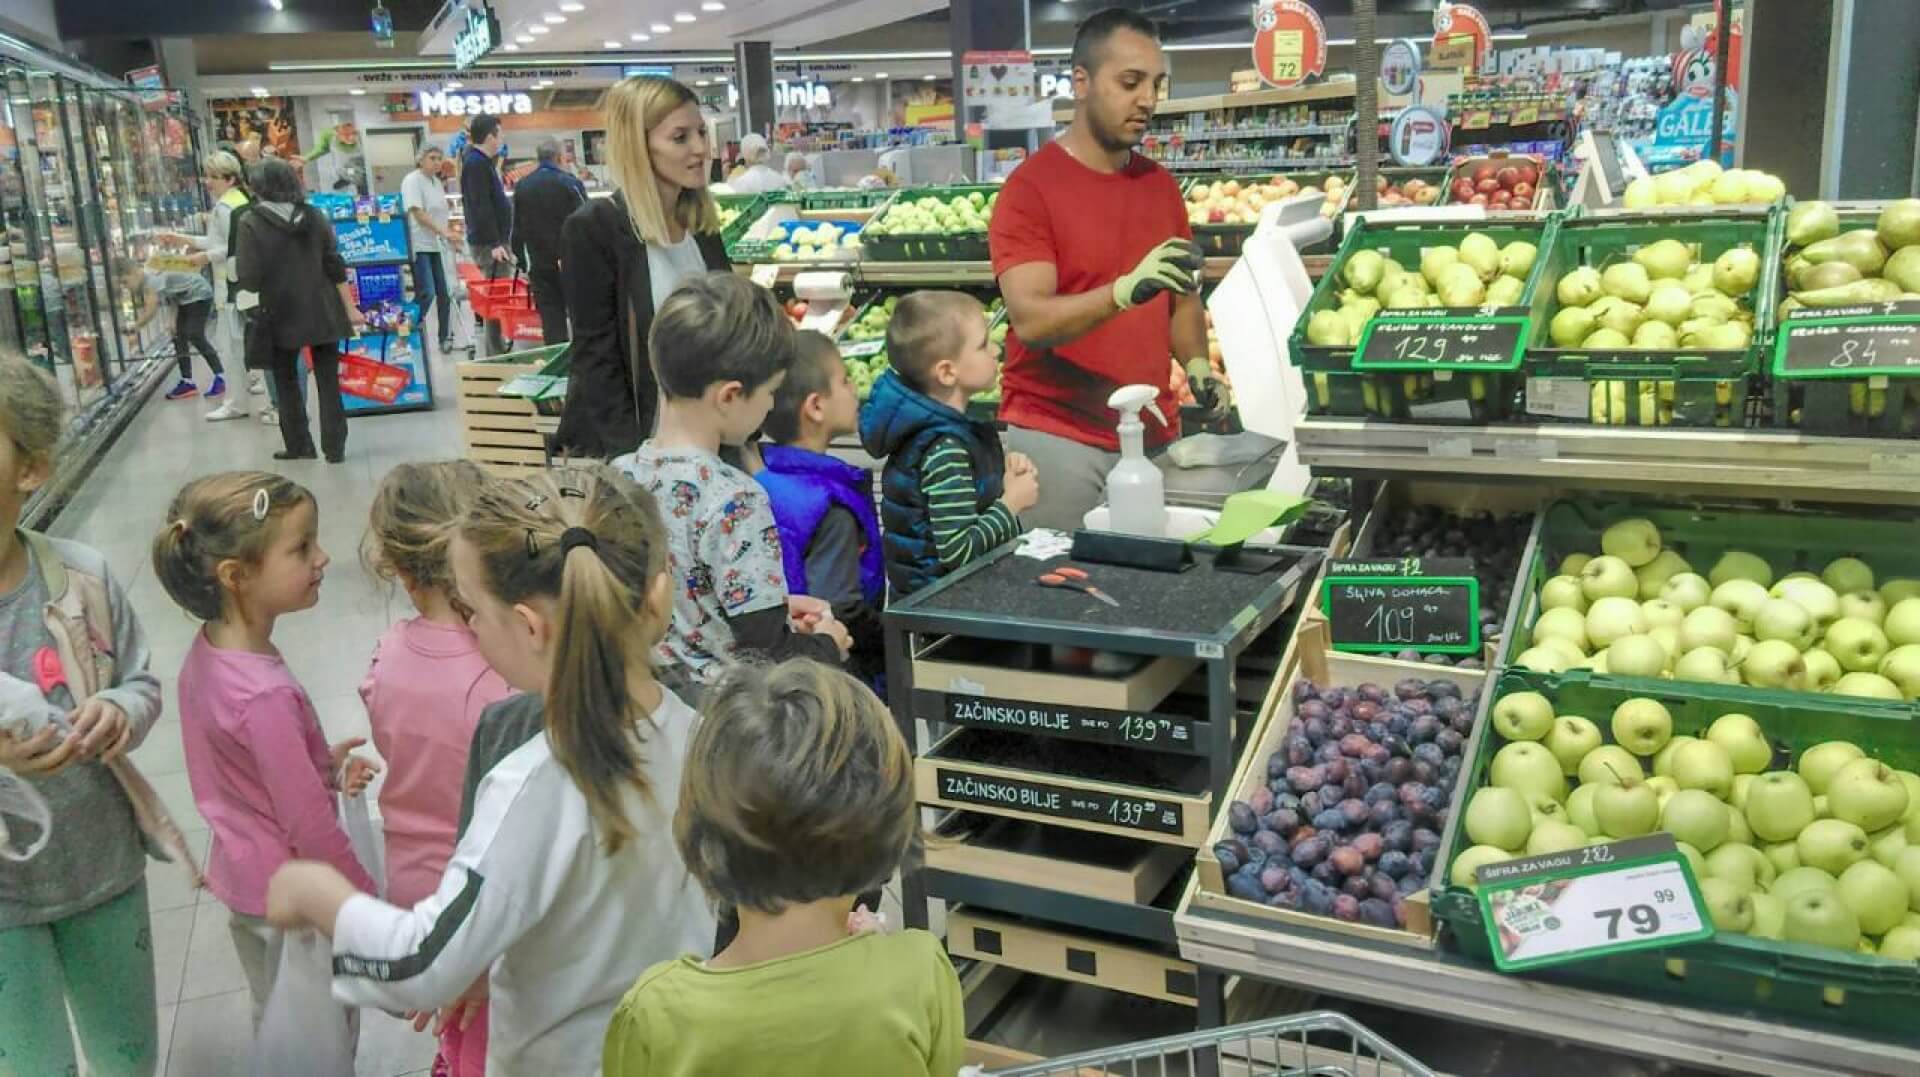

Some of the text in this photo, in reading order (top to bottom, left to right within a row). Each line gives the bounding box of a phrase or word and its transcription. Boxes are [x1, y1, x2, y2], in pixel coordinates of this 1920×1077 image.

[1279, 62, 1297, 77] 72
[420, 91, 533, 116] Mesara
[1395, 336, 1448, 363] 129
[1829, 338, 1876, 367] 84
[1399, 557, 1424, 576] 72
[1365, 604, 1415, 643] 109
[954, 701, 1027, 726] ZAČINSKO
[1029, 710, 1071, 731] BILJE
[1118, 715, 1157, 741] 139
[946, 776, 1018, 803] ZAČINSKO
[1020, 787, 1061, 810] BILJE
[1108, 799, 1143, 826] 139
[1483, 864, 1522, 879] ŠIFRA
[1521, 861, 1539, 874] ZA
[1538, 855, 1572, 870] VAGU
[1653, 887, 1676, 904] 99
[1593, 903, 1661, 941] 79
